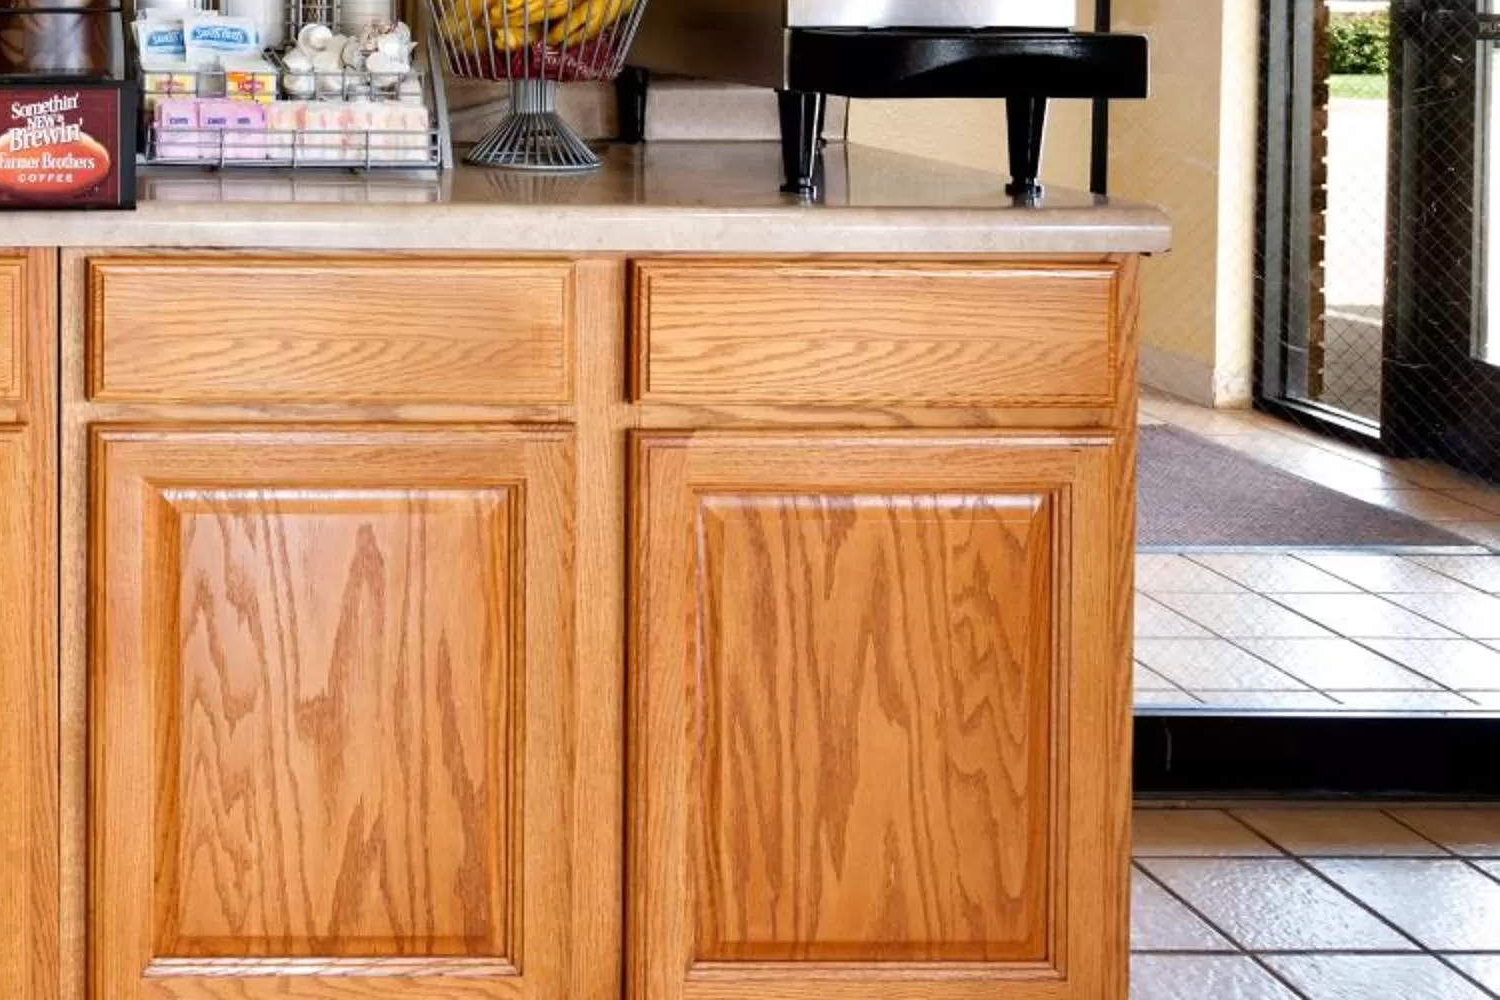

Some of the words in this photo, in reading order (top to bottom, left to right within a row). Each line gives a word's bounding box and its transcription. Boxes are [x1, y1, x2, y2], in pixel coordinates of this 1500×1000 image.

[11, 92, 80, 120] Somethin'
[9, 117, 83, 152] Brewin'
[42, 152, 95, 169] Brothers
[18, 173, 73, 184] COFFEE
